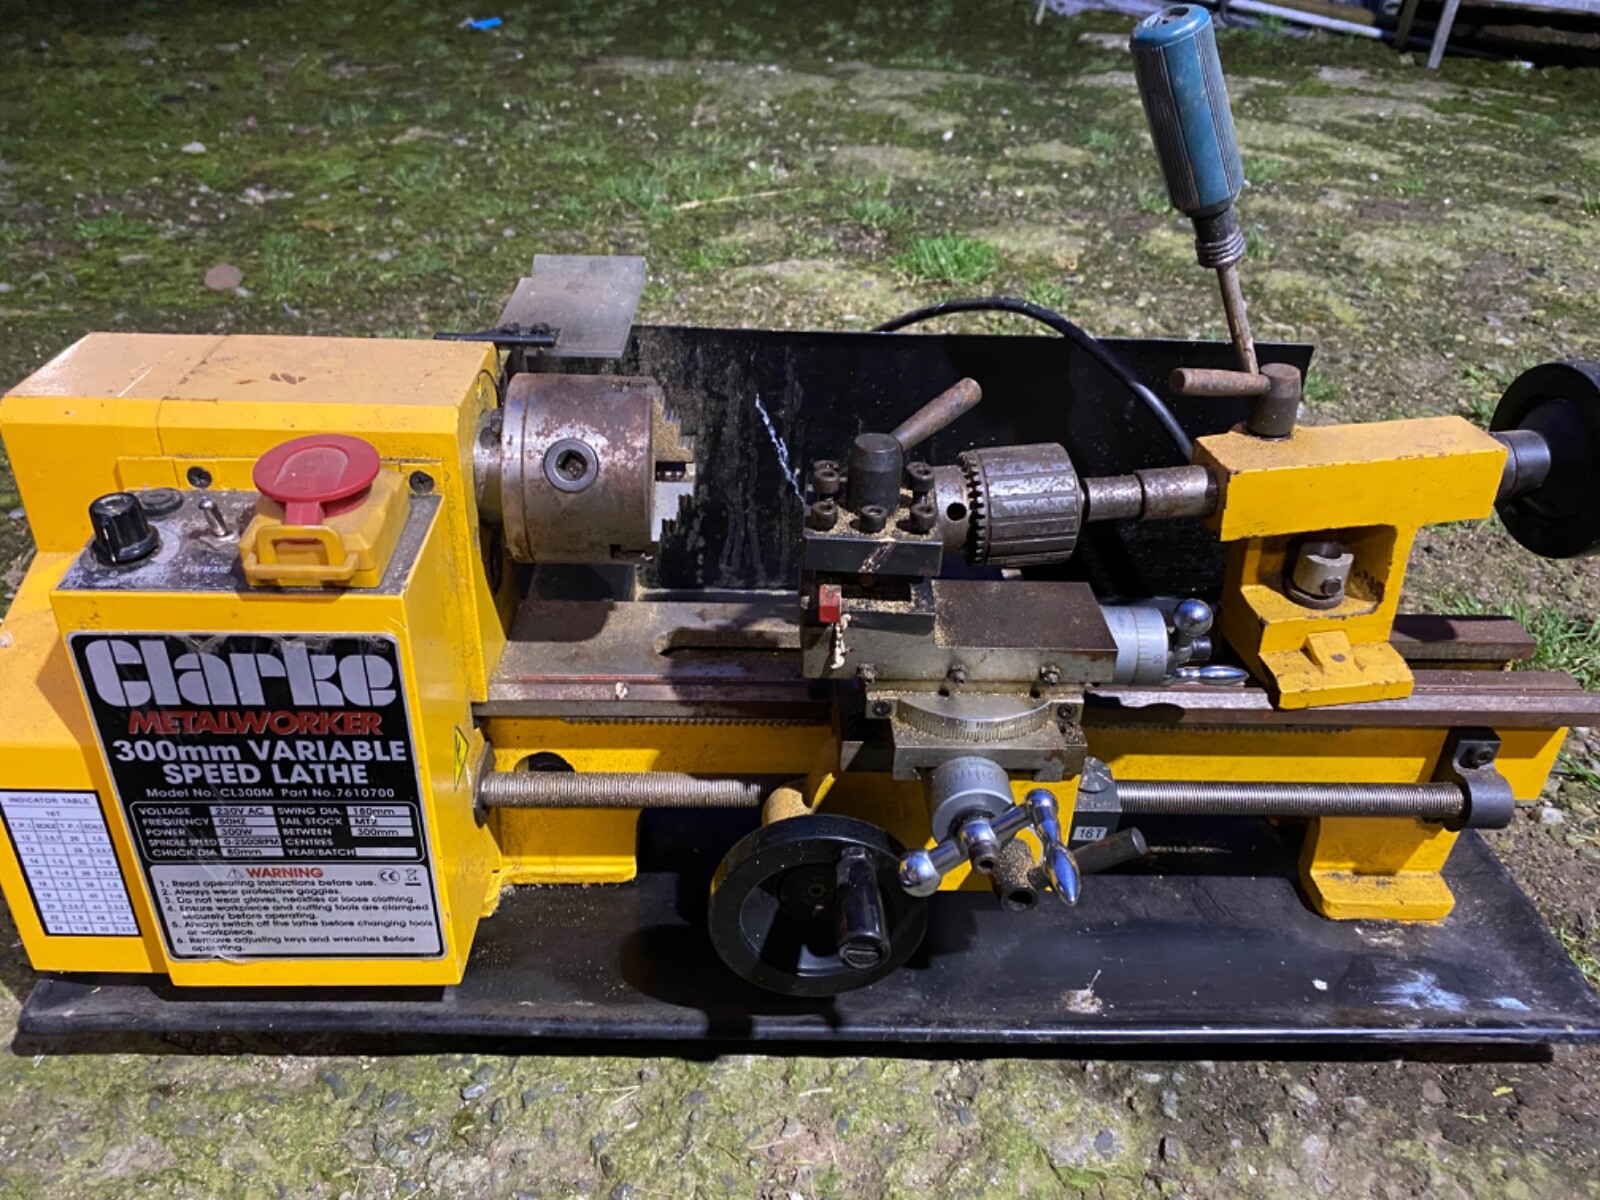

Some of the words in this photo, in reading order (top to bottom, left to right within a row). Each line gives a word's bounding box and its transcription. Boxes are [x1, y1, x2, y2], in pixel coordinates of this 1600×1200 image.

[84, 639, 397, 707] Clarke
[128, 710, 384, 736] METALWORKER
[113, 740, 241, 762] 300mm
[247, 739, 407, 762] VARIABLE
[162, 763, 261, 785] SPEED
[271, 763, 368, 785] LATHE
[145, 788, 189, 797] Model
[220, 788, 274, 797] CL300M
[281, 788, 307, 798] Part
[61, 797, 91, 805] TABLE
[138, 807, 192, 815] VOLTAGE
[215, 807, 244, 815] 230V
[248, 807, 265, 815] AC
[277, 807, 316, 815] SWING
[320, 807, 343, 815] DIA.
[353, 807, 395, 816] 180mm
[142, 817, 209, 826] FREQUENCY
[280, 817, 301, 826] TAIL
[306, 817, 343, 826] STOCK
[145, 828, 186, 836] POWER
[222, 828, 252, 836] 300W
[282, 828, 332, 836] BETWEEN
[358, 828, 399, 836] 300mm
[1080, 828, 1104, 839] 16T
[148, 838, 186, 847] SPINDLE
[188, 838, 217, 847] SPEED
[285, 838, 334, 846] CENTRES
[152, 848, 195, 857] CHUCK
[287, 848, 355, 857] YEAR/BATCH
[246, 867, 324, 878] WARNING
[203, 880, 255, 890] operating
[174, 889, 210, 897] Always
[241, 888, 294, 897] protective
[296, 888, 342, 897] goggles.
[195, 896, 212, 904] not
[244, 896, 280, 906] gloves,
[282, 896, 325, 904] neckties
[371, 896, 416, 905] clothing.
[216, 904, 269, 913] workpiece
[296, 904, 333, 913] cutting
[382, 904, 429, 913] clamped
[228, 912, 263, 920] before
[264, 912, 317, 922] operating.
[185, 920, 219, 929] Always
[222, 920, 254, 928] switch
[357, 920, 407, 929] changing
[189, 936, 231, 944] Remove
[234, 936, 281, 945] adjusting
[284, 935, 307, 944] keys
[309, 935, 330, 943] and
[332, 935, 381, 943] wrenches
